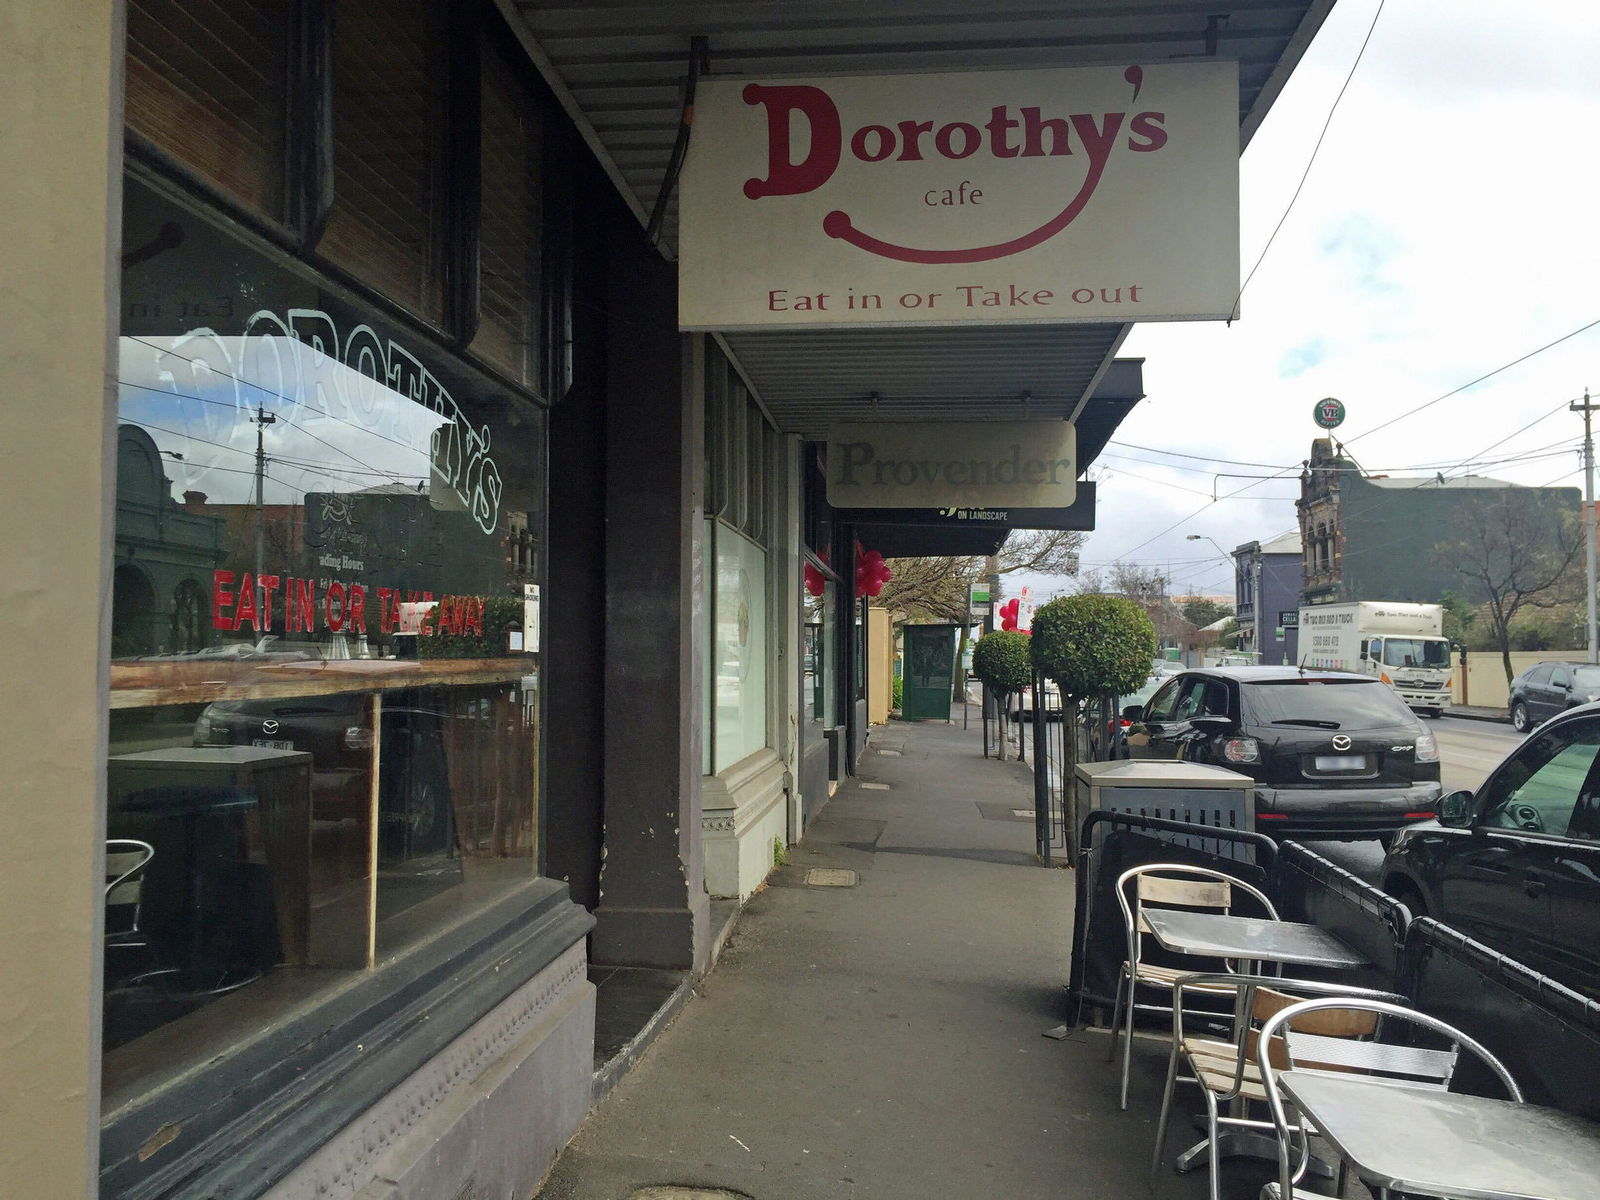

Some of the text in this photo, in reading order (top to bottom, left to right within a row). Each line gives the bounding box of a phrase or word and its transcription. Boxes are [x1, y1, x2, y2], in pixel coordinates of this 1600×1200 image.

[742, 65, 1168, 263] Dorothy's
[924, 181, 983, 206] cafe
[768, 284, 1143, 312] Eat in or Take out
[834, 441, 1071, 486] Provender
[957, 510, 1008, 520] ON LANDSCAPE
[342, 555, 364, 571] Hours
[212, 569, 280, 632] EAT
[285, 577, 315, 633] IN
[326, 582, 367, 633] OR
[437, 594, 489, 637] AWAY
